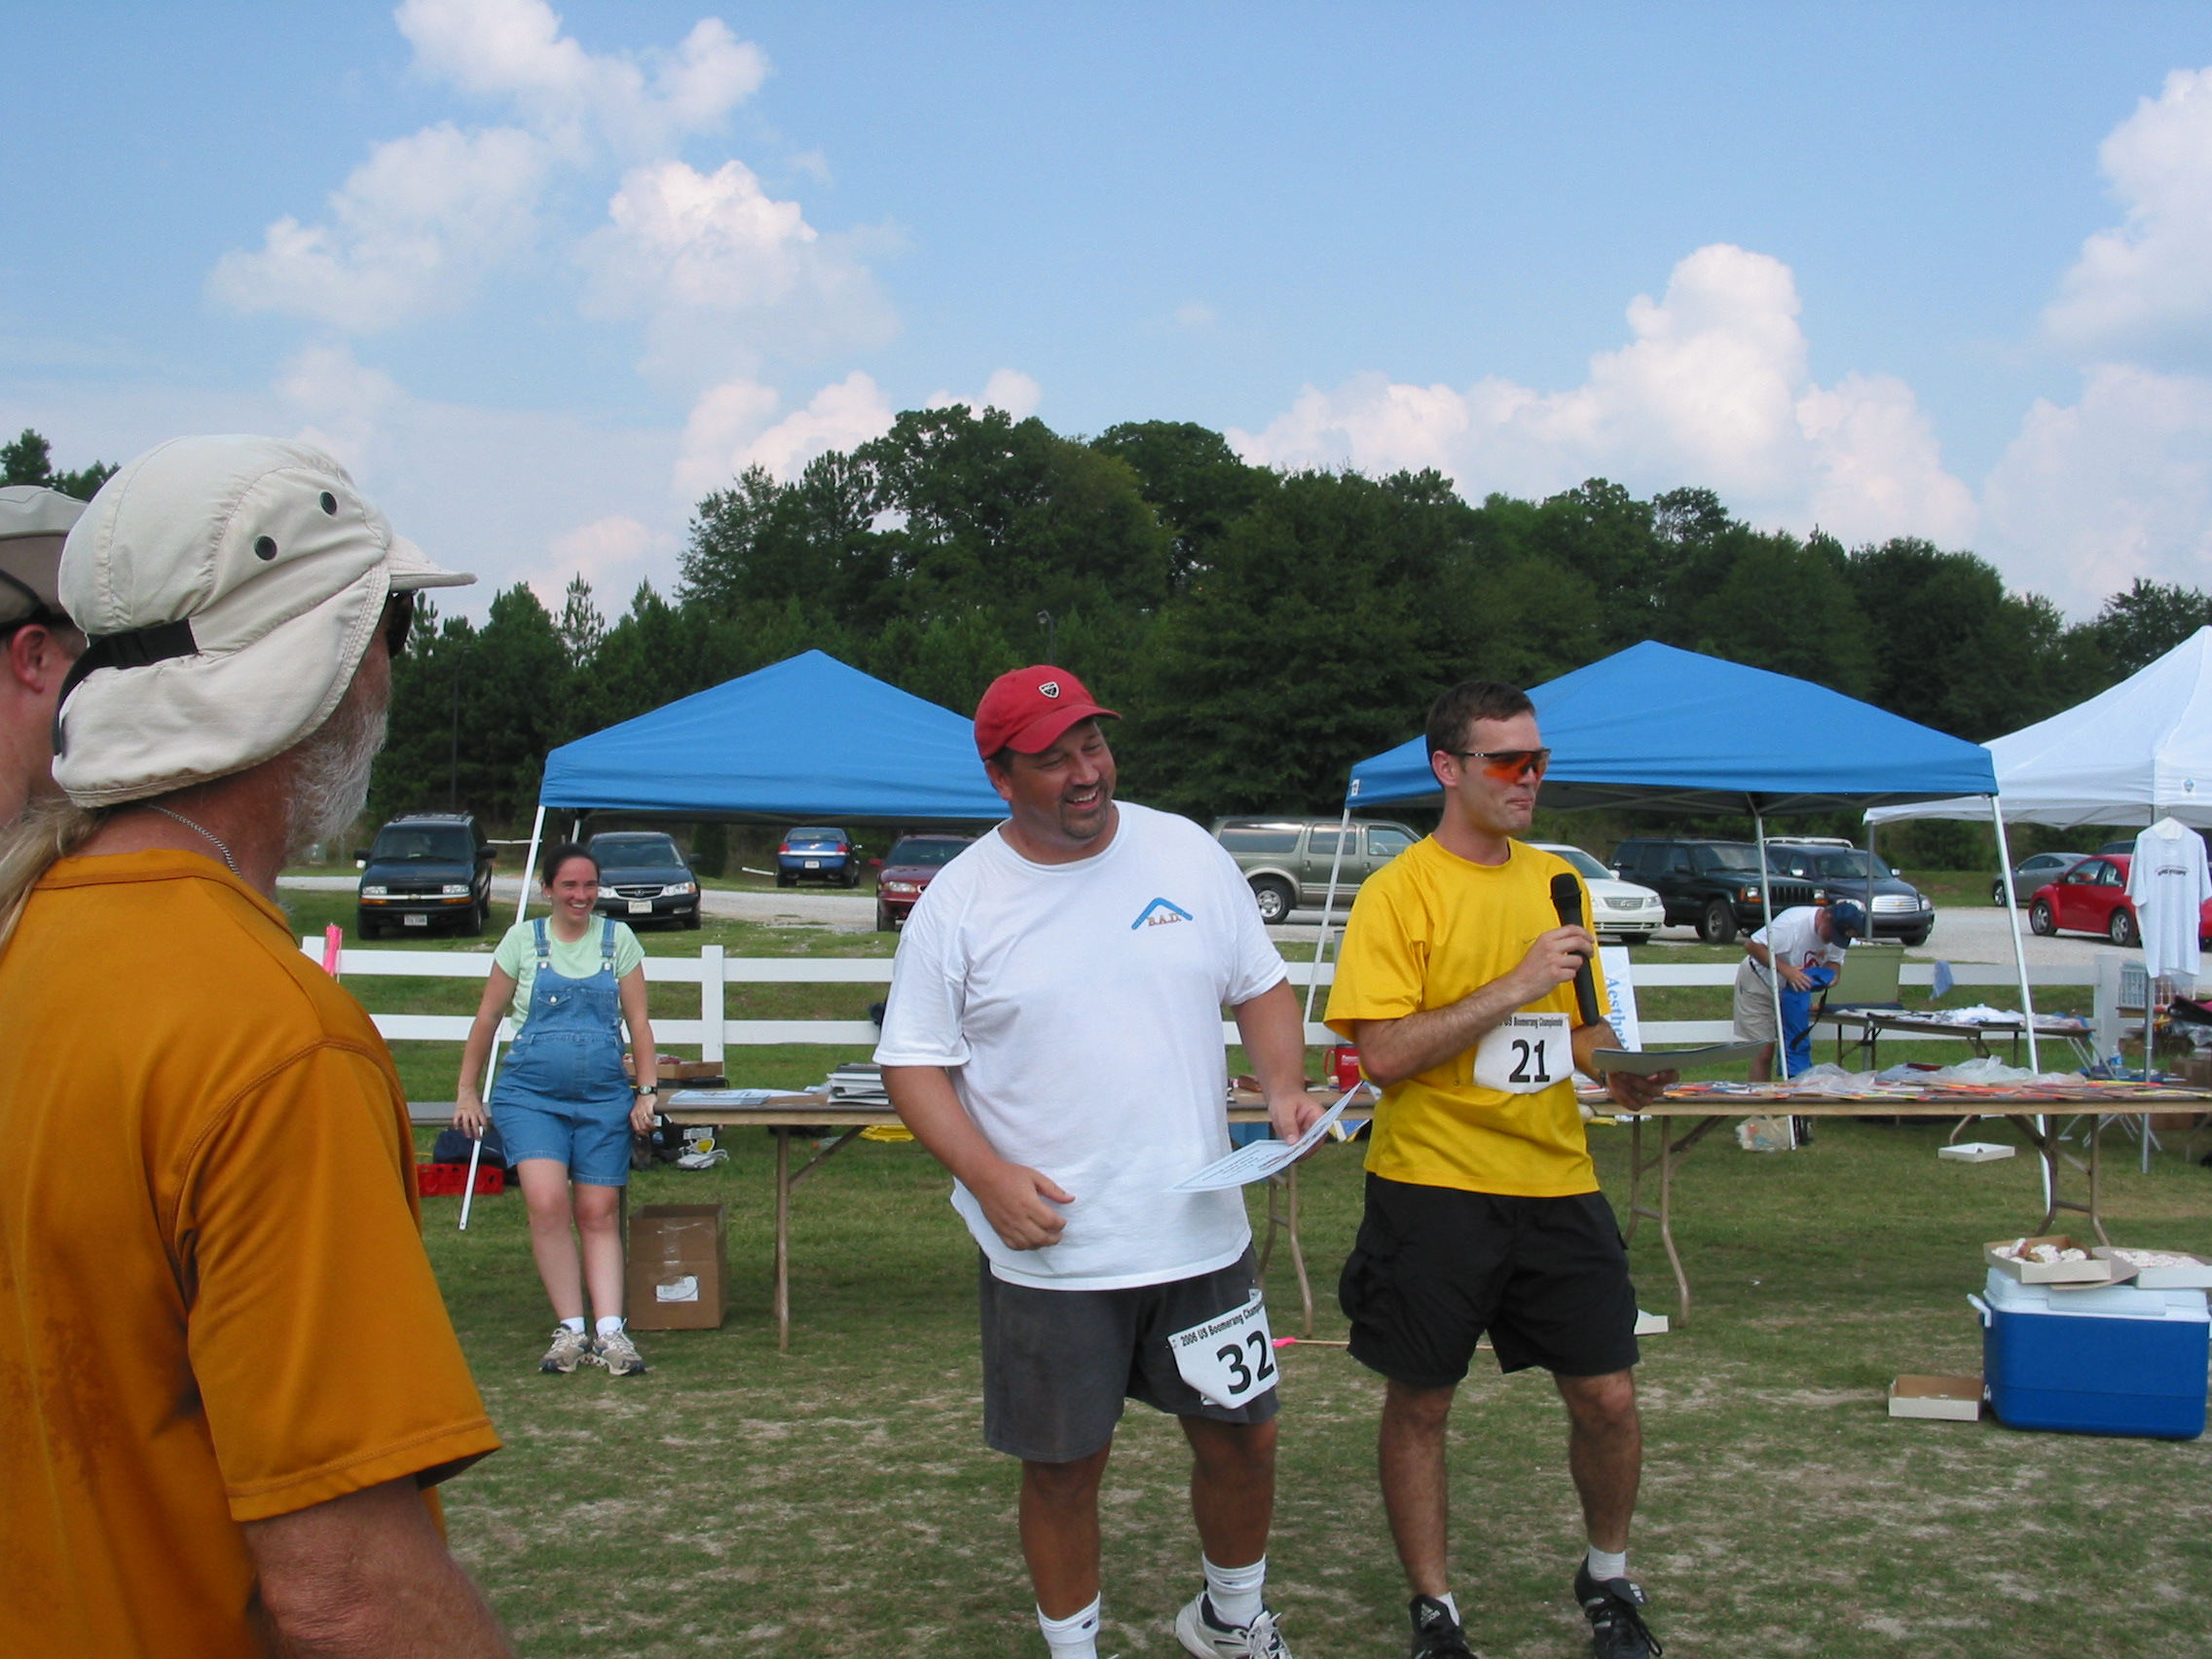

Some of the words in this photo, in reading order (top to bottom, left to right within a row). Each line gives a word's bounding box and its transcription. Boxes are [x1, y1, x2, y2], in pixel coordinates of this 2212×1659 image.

[1509, 1039, 1550, 1083] 21
[1198, 1326, 1208, 1341] US
[1208, 1313, 1244, 1336] Boomerang
[1216, 1330, 1274, 1395] 32
